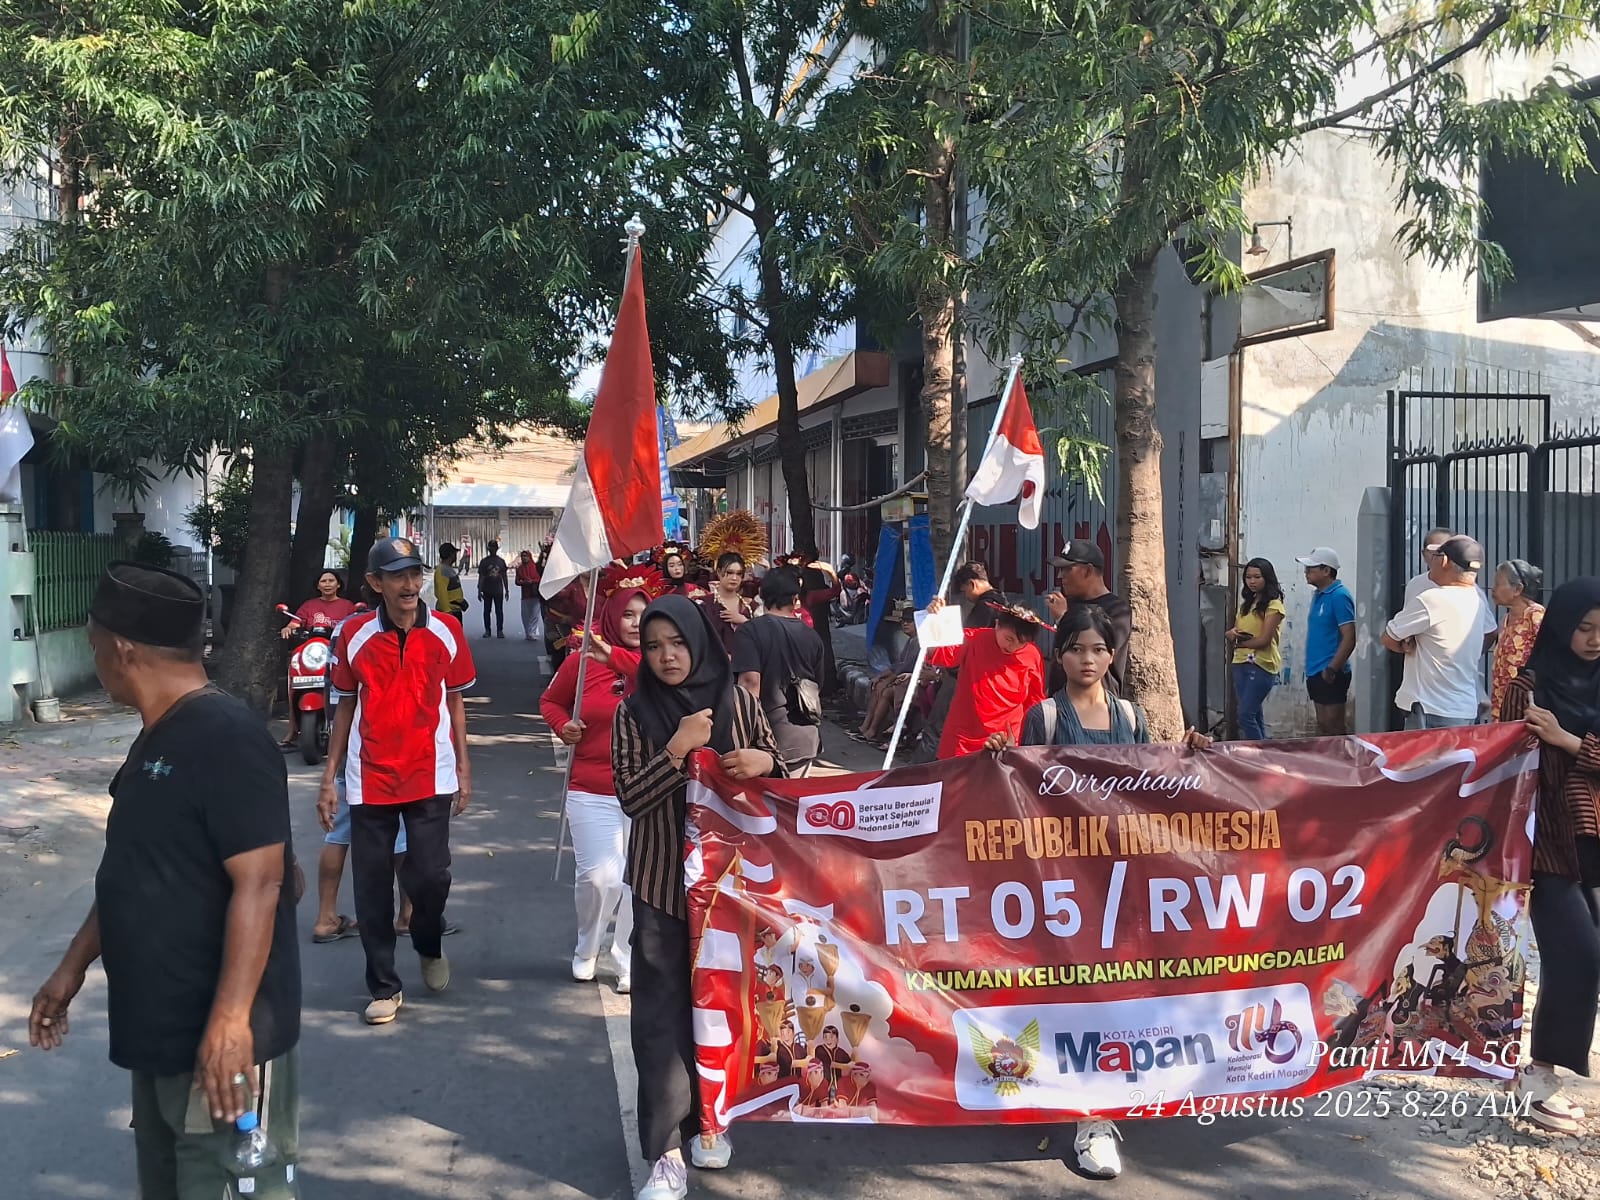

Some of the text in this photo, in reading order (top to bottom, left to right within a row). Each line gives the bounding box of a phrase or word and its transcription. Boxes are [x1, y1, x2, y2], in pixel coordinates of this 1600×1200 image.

[1038, 765, 1203, 800] Dirgahayu
[859, 796, 934, 812] Bersatu Berdaulat
[859, 807, 929, 824] Rakyat Sejahtera
[858, 818, 920, 832] Indonesia Maju
[965, 809, 1282, 862] REPUBLIK INDONESIA
[882, 861, 1367, 949] RT 05 / RW 02
[906, 942, 1346, 992] KAUMAN KELURAHAN KAMPUNGDALEM
[1103, 1025, 1174, 1041] KOTA KEDIRI
[1054, 1031, 1216, 1083] Mapan
[1226, 1068, 1309, 1083] Kota Kediri Mapan
